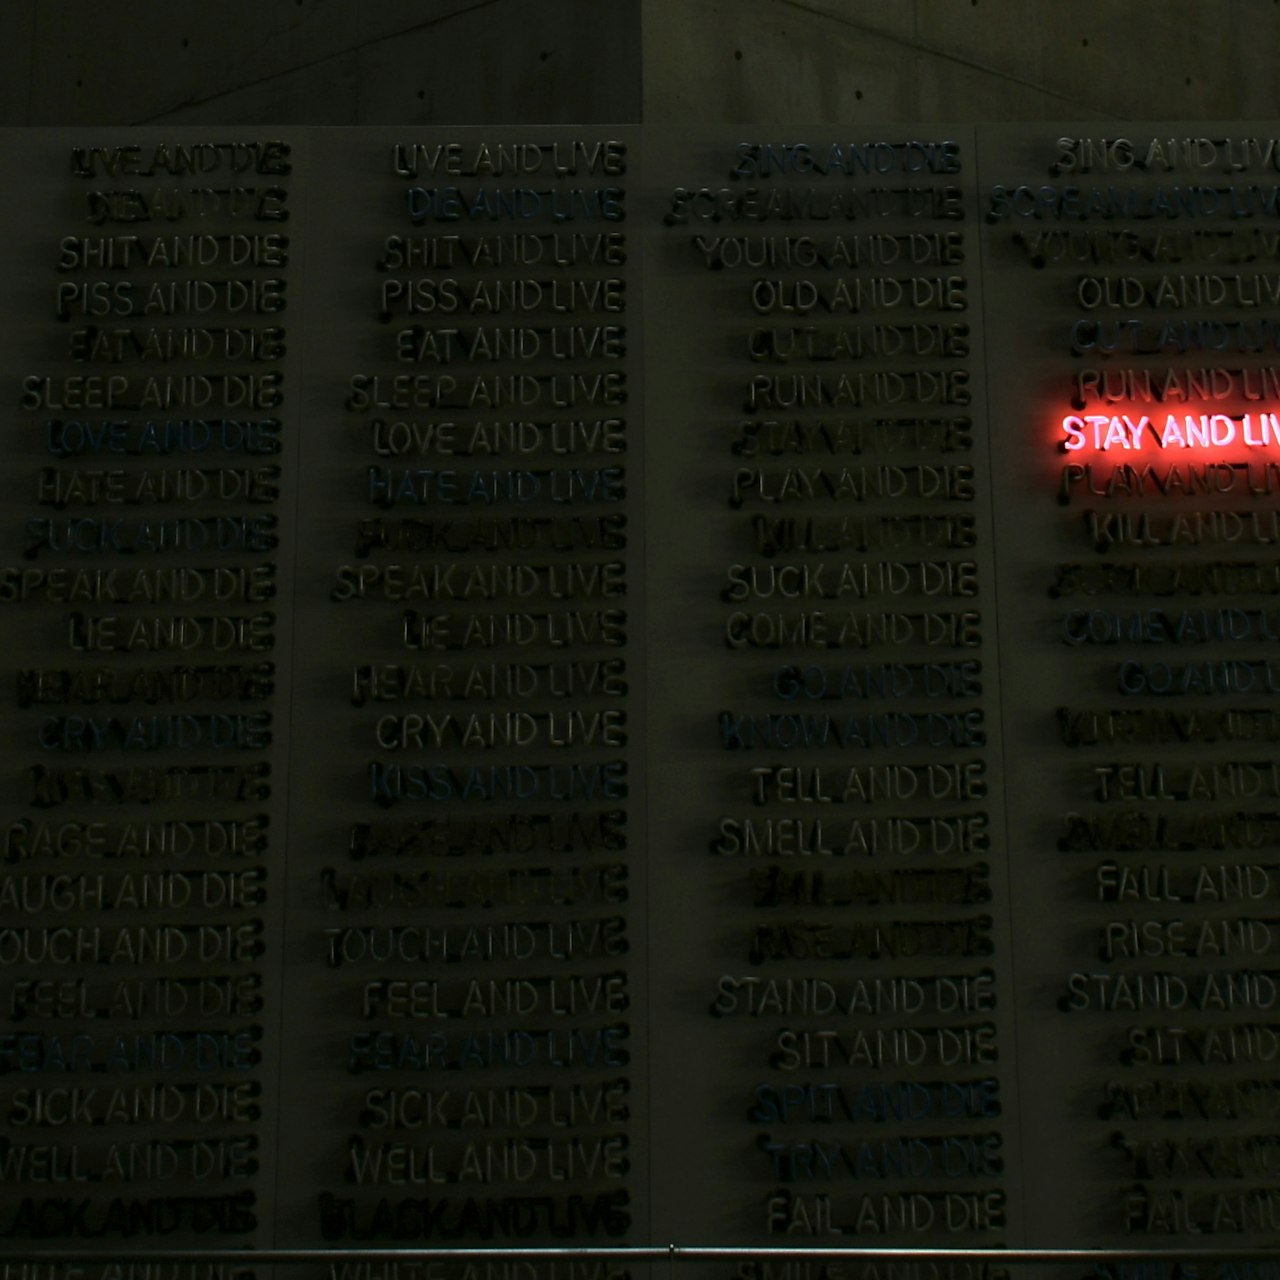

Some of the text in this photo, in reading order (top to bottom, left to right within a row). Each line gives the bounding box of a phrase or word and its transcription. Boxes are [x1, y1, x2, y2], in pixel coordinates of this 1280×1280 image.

[394, 142, 624, 176] LIVE AND LIVE
[1055, 139, 1134, 173] SING
[1149, 139, 1215, 172] AND
[59, 235, 283, 270] SHIT AND DIE
[385, 234, 623, 270] SHIT AND LIVE
[698, 233, 963, 269] YOUNG AND DIE
[58, 281, 283, 316] PISS AND DIE
[381, 279, 623, 314] PISS AND LIVE
[751, 278, 967, 312] OLD AND DIE
[1078, 276, 1144, 309] OLD
[1156, 275, 1225, 308] AND
[397, 327, 624, 362] EAT AND LIVE
[748, 325, 967, 360] CUT AND DIE
[24, 375, 281, 410] SLEEP AND DIE
[349, 374, 623, 409] SLEEP AND LIVE
[751, 372, 970, 408] RUN AND DIE
[1078, 369, 1153, 401] RUN
[1163, 369, 1232, 400] AND
[373, 421, 623, 456] LOVE AND LIVE
[1062, 415, 1153, 451] STAY
[1161, 414, 1235, 449] AND
[39, 469, 280, 503] HATE AND DIE
[733, 467, 974, 501] PLAY AND DIE
[1062, 464, 1154, 498] PLAY
[1169, 463, 1236, 496] AND
[1091, 512, 1158, 548] KILL
[1171, 511, 1243, 544] AND
[131, 569, 206, 601] AND
[218, 567, 273, 601] DIE
[333, 564, 624, 600] SPEAK AND LIVE
[728, 561, 978, 600] SUCK AND DIE
[69, 616, 273, 650] LIE AND DIE
[403, 612, 624, 649] LIE AND LIVE
[727, 613, 980, 648] COME AND DIE
[353, 663, 624, 700] HEAR AND LIVE
[377, 714, 624, 750] CRY AND LIVE
[370, 763, 625, 801] KISS AND LIVE
[753, 764, 986, 803] TELL AND DIE
[1095, 767, 1179, 802] TELL
[1189, 765, 1262, 799] AND
[4, 822, 261, 858] RAGE AND DIE
[720, 818, 989, 855] SMELL AND DIE
[117, 873, 189, 911] AND
[202, 871, 261, 909] DIE
[1097, 864, 1182, 900] FALL
[1195, 863, 1269, 898] AND
[110, 928, 188, 964] AND
[200, 926, 260, 963] DIE
[325, 925, 623, 965] TOUCH AND LIVE
[1106, 922, 1186, 960] RISE
[1196, 921, 1271, 957] AND
[11, 978, 259, 1019] FEEL AND DIE
[363, 980, 624, 1019] FEEL AND LIVE
[719, 976, 996, 1015] STAND AND DIE
[1068, 975, 1188, 1011] STAND
[1201, 975, 1275, 1011] AND
[778, 1028, 999, 1069] SIT AND DIE
[1129, 1030, 1189, 1065] SIT
[1202, 1029, 1277, 1064] AND
[10, 1085, 257, 1126] SICK AND DIE
[364, 1087, 627, 1129] SICK AND LIVE
[102, 1144, 179, 1182] AND
[192, 1142, 257, 1180] DIE
[349, 1142, 624, 1183] WELL AND LIVE
[769, 1194, 1005, 1234] FAIL AND DIE
